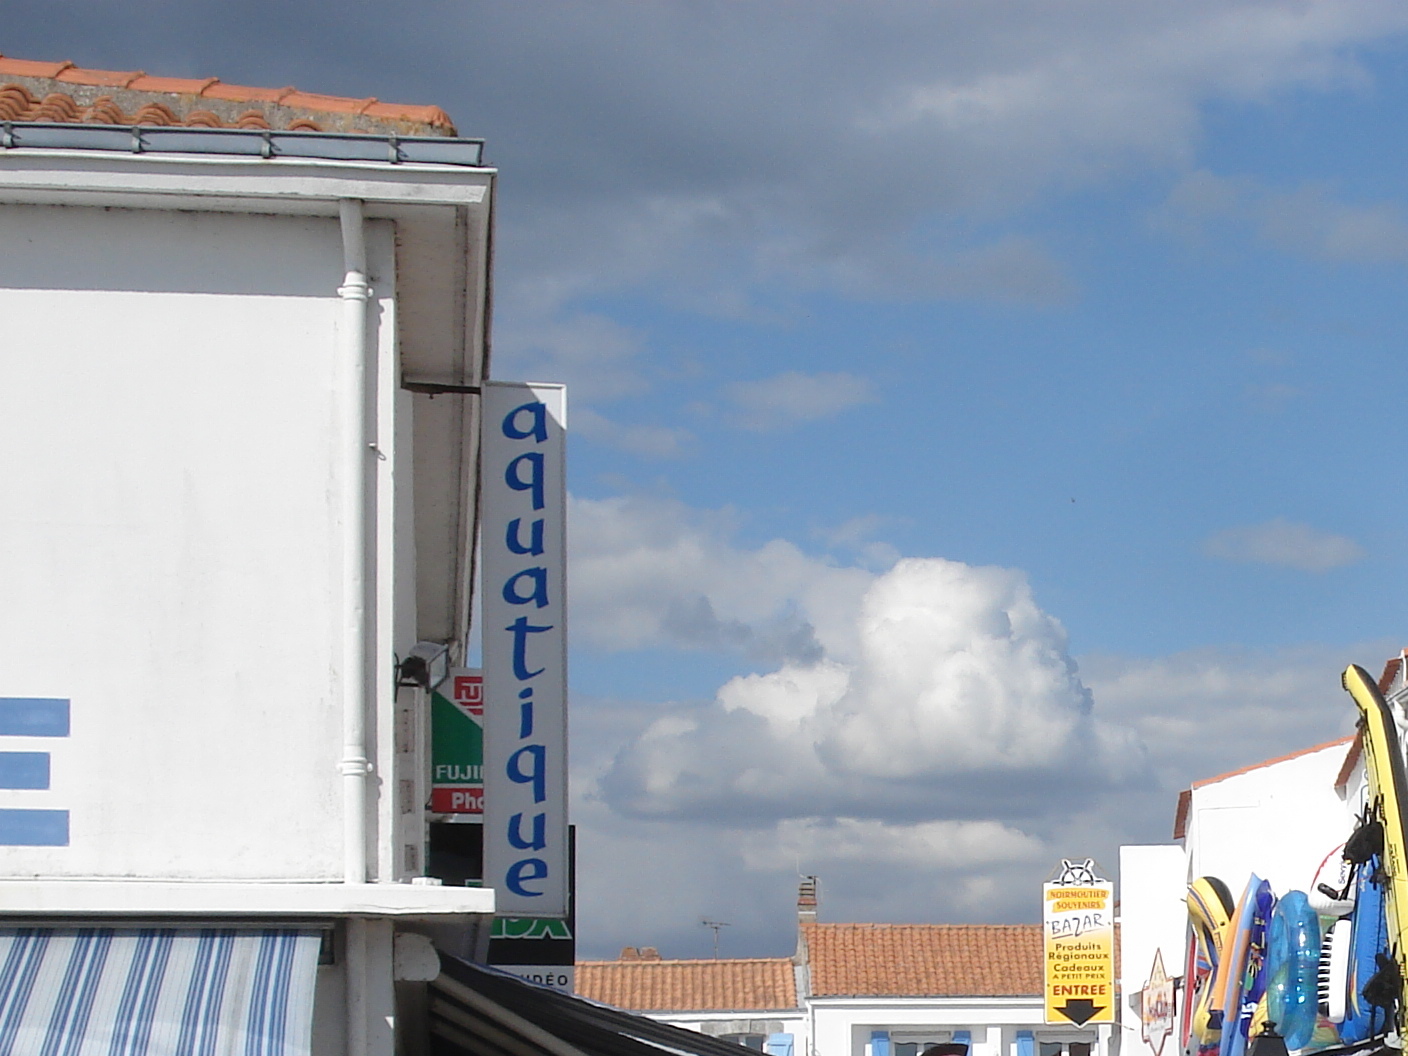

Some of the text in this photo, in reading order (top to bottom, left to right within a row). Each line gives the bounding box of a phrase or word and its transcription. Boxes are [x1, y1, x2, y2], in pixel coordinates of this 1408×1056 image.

[502, 402, 554, 897] aquatique
[436, 764, 483, 780] FUJI
[1050, 890, 1107, 899] NOIRMOUTIER
[1056, 901, 1101, 910] SOUVENIRS
[1051, 913, 1104, 938] BAZAR
[1055, 942, 1102, 951] Produits
[1048, 951, 1110, 962] Régionaux
[1053, 963, 1105, 972] Cadeaux
[1053, 984, 1106, 996] ENTREE
